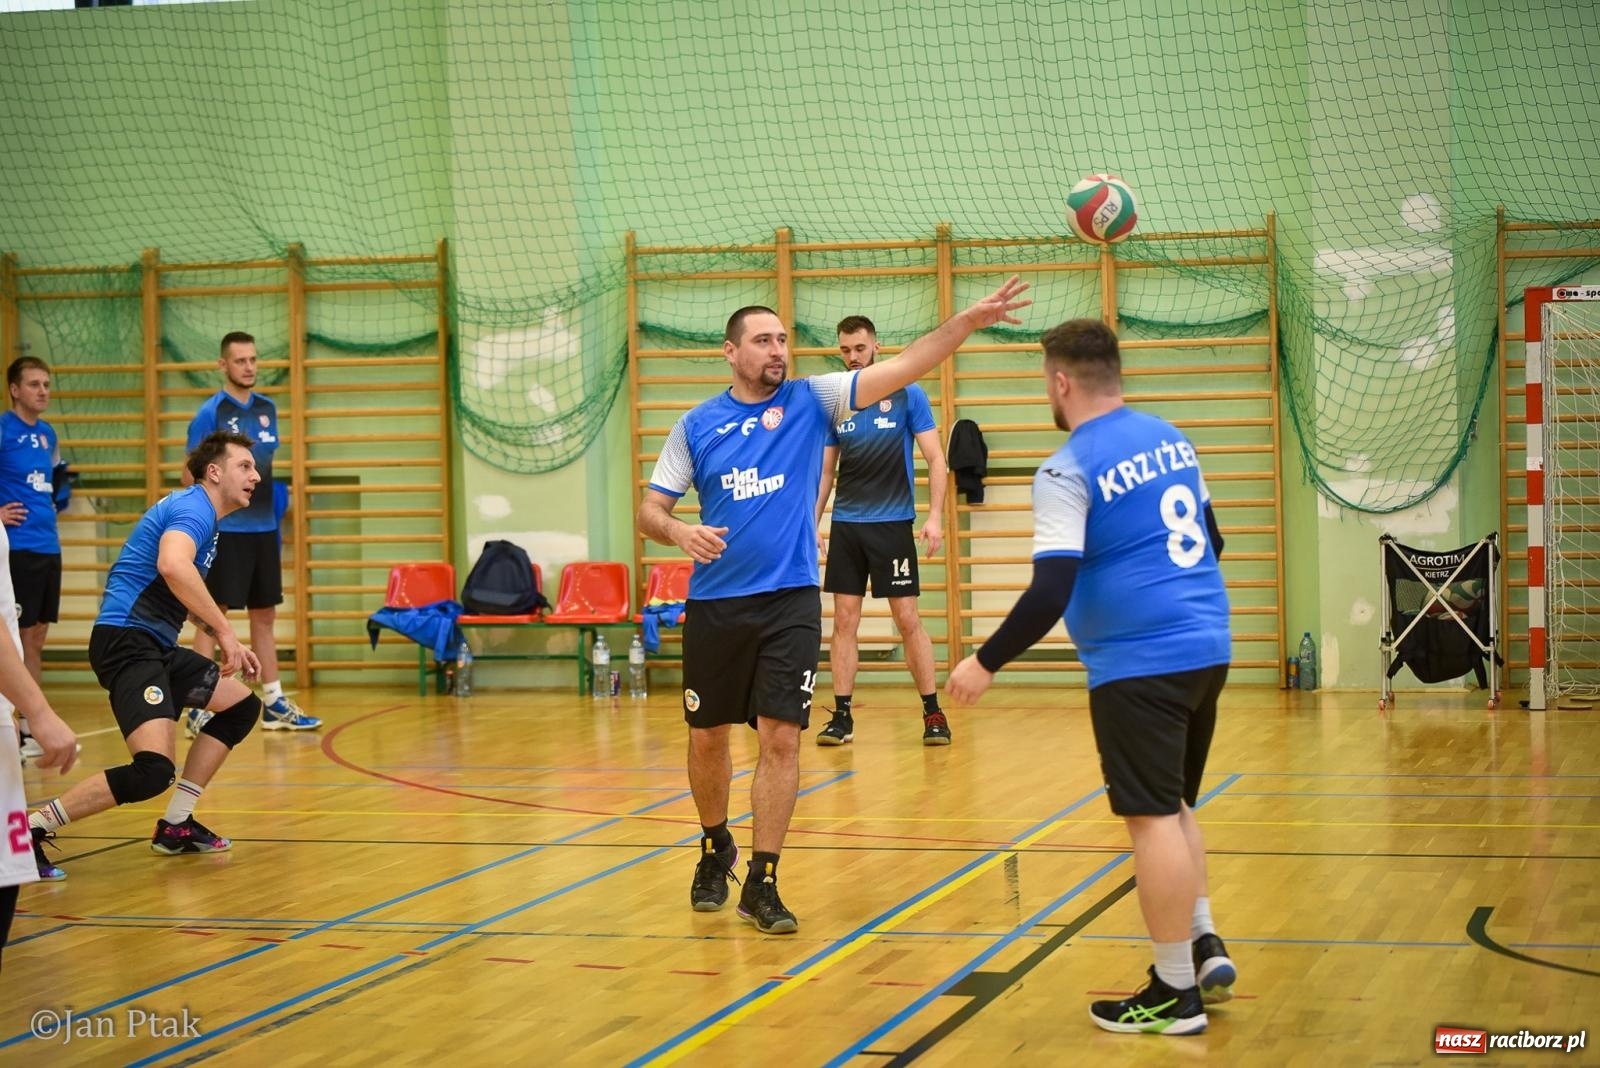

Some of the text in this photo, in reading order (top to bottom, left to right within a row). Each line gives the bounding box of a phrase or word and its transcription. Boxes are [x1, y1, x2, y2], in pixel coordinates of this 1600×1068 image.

[30, 433, 39, 448] 5
[1160, 484, 1206, 568] 8
[892, 558, 910, 576] 14
[7, 810, 33, 855] 2
